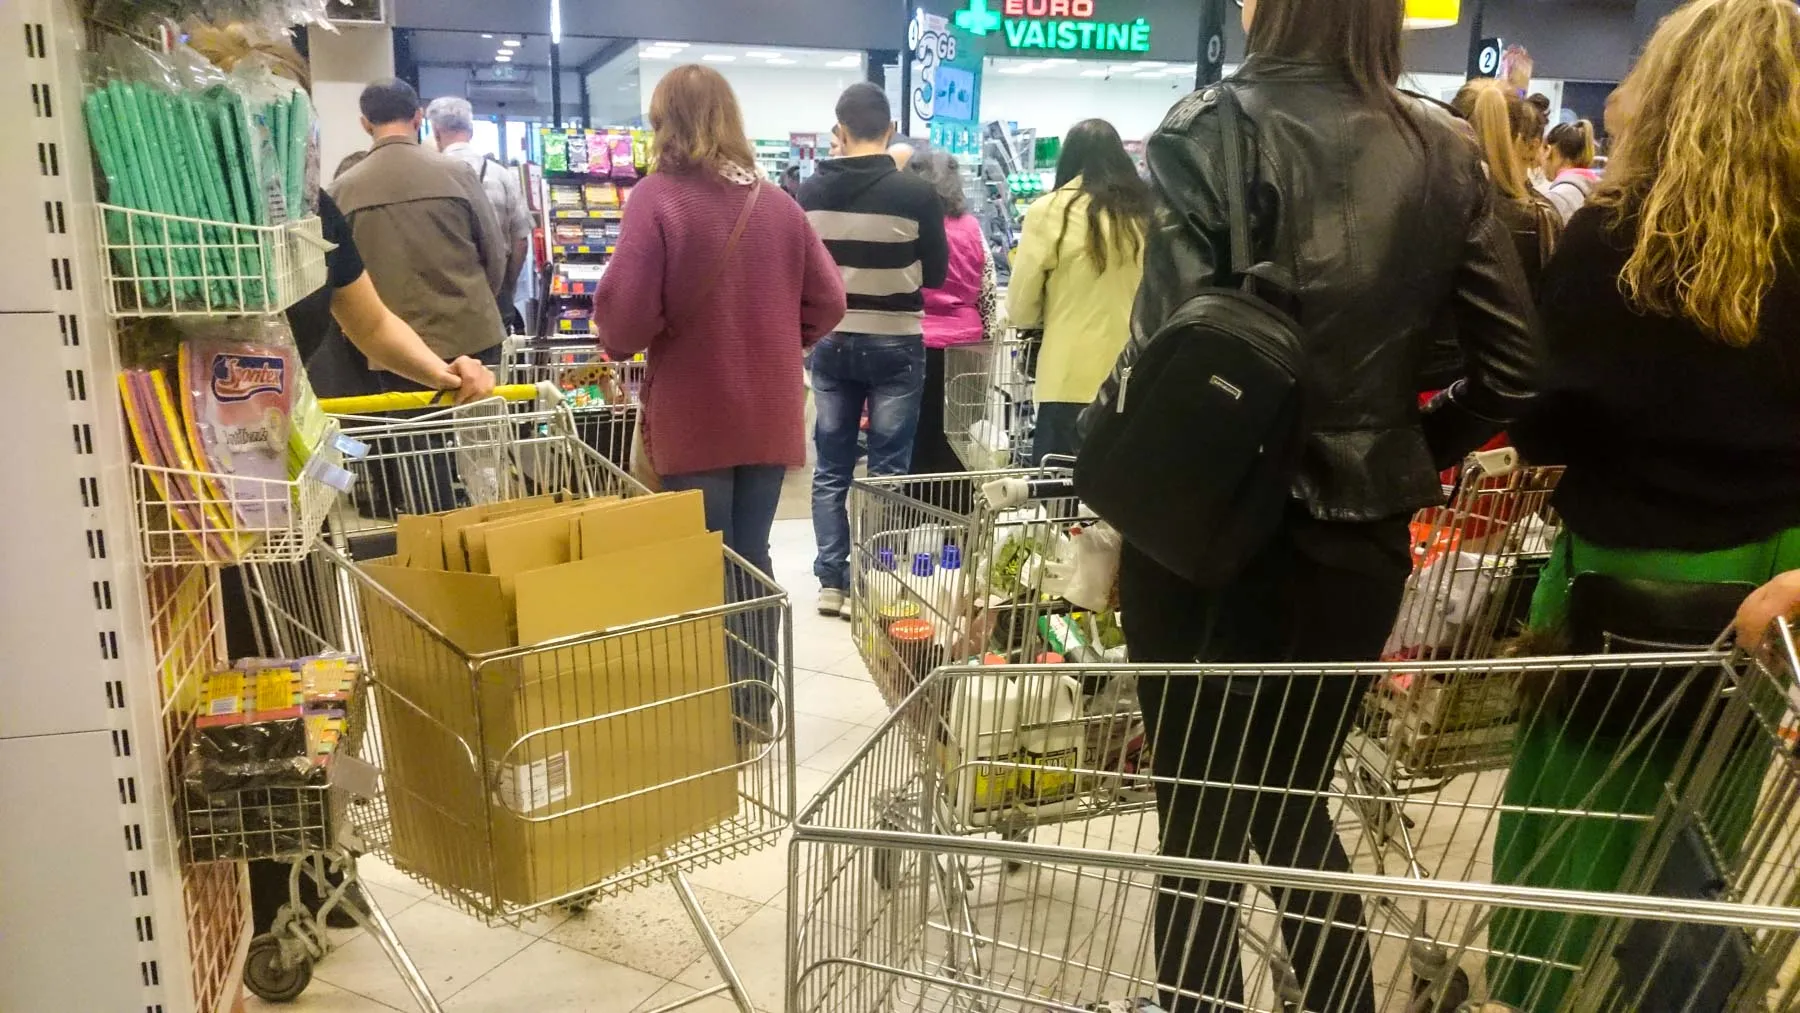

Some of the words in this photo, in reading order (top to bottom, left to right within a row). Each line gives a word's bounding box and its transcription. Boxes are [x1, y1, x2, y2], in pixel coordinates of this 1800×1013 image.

[1005, 0, 1094, 17] EURO
[937, 33, 956, 61] GB
[1484, 51, 1491, 68] 2
[216, 358, 282, 394] Spontex
